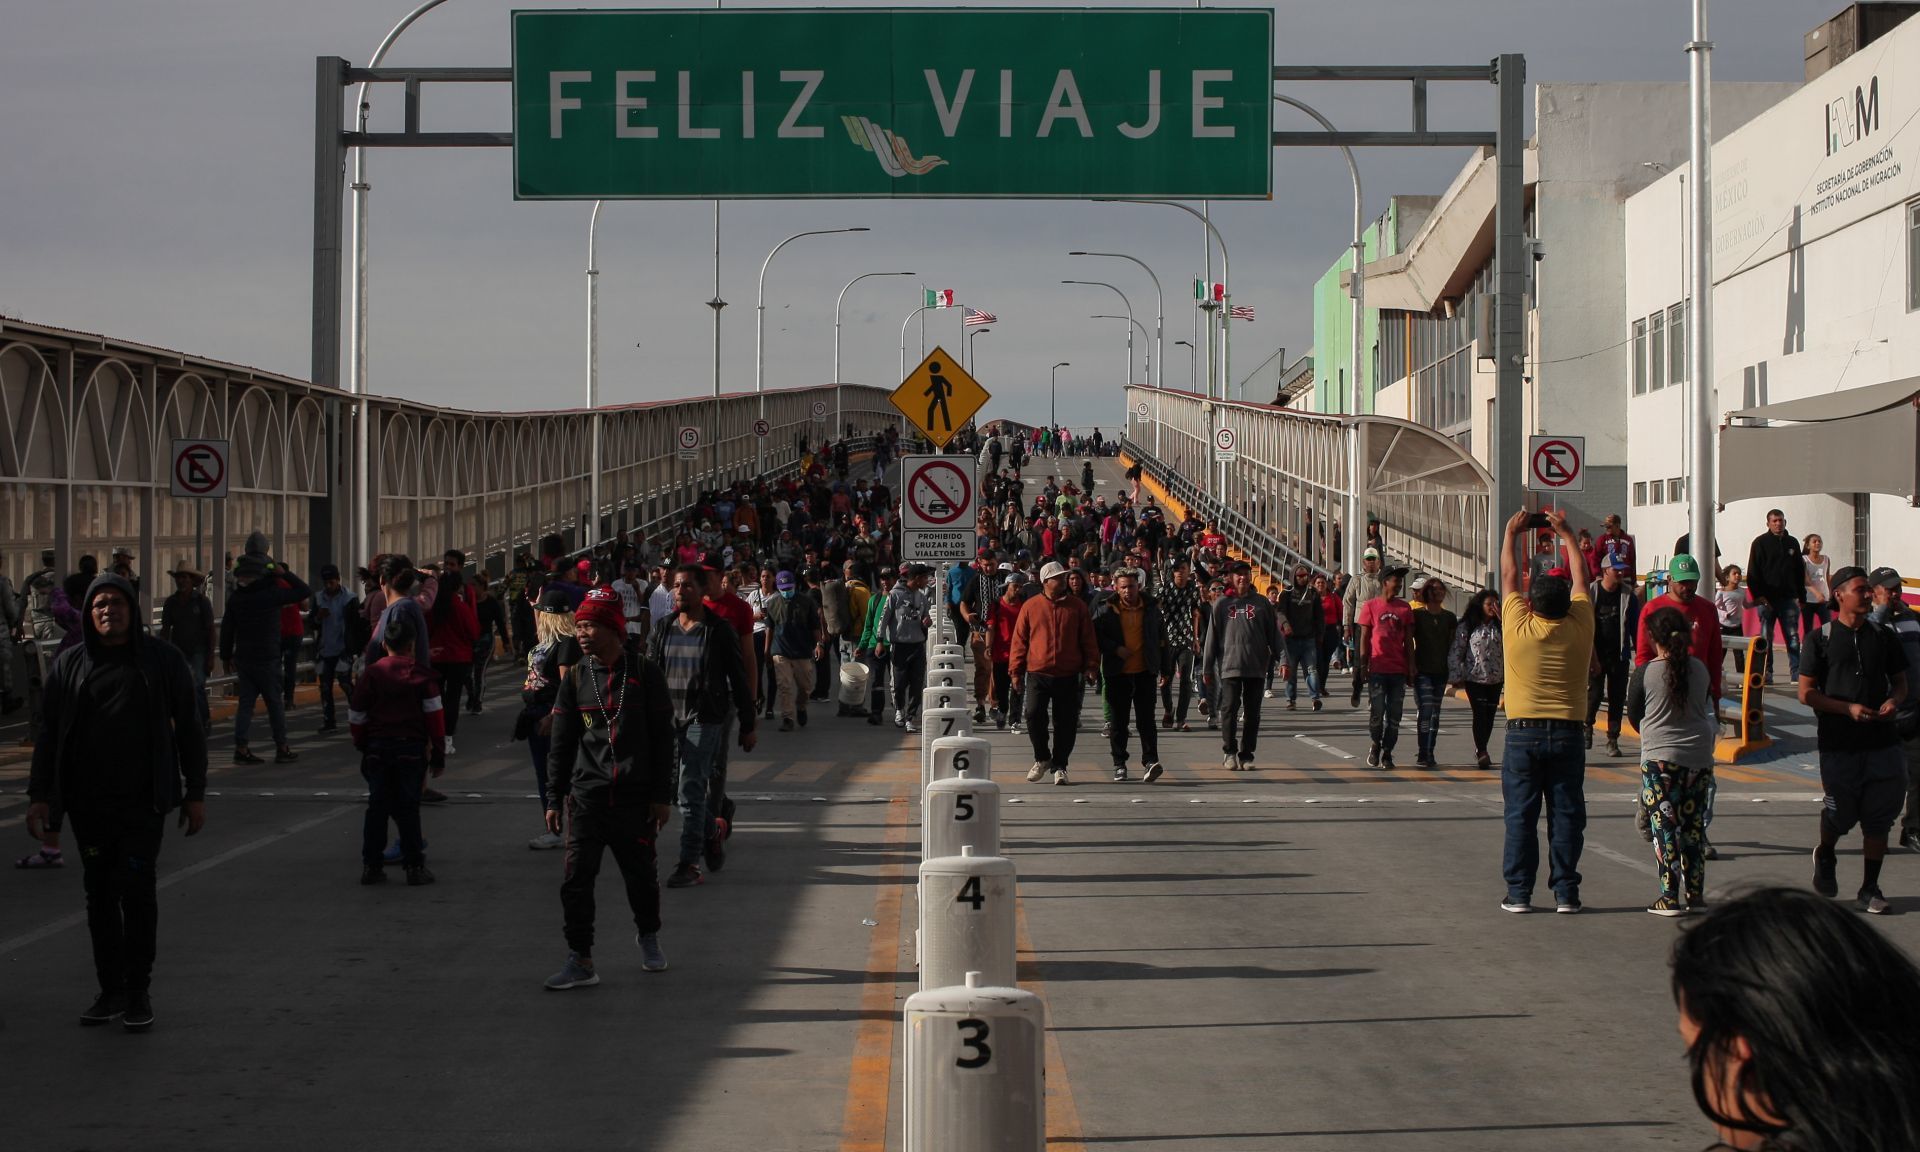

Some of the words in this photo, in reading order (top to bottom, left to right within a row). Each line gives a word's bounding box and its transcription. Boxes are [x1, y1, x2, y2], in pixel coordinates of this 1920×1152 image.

[548, 70, 825, 138] FELIZ
[923, 69, 1237, 138] VIAJE
[1816, 170, 1847, 196] SECRETARÍA
[1846, 168, 1855, 182] DE
[1854, 146, 1894, 177] GOBERNACIÓN
[1810, 196, 1835, 217] INSTITUTO
[1835, 182, 1862, 204] NACIONAL
[1861, 178, 1870, 193] DE
[1869, 161, 1902, 187] MIGRACIÓN
[1715, 209, 1767, 254] GOBERNACIÓN
[685, 432, 695, 441] 15
[1220, 433, 1230, 443] 15
[914, 541, 948, 549] CRUZAR
[950, 541, 966, 549] LOS
[939, 695, 951, 708] 8
[941, 717, 955, 735] 7
[952, 750, 970, 771] 6
[954, 794, 975, 821] 5
[956, 875, 985, 911] 4
[955, 1018, 992, 1069] 3
